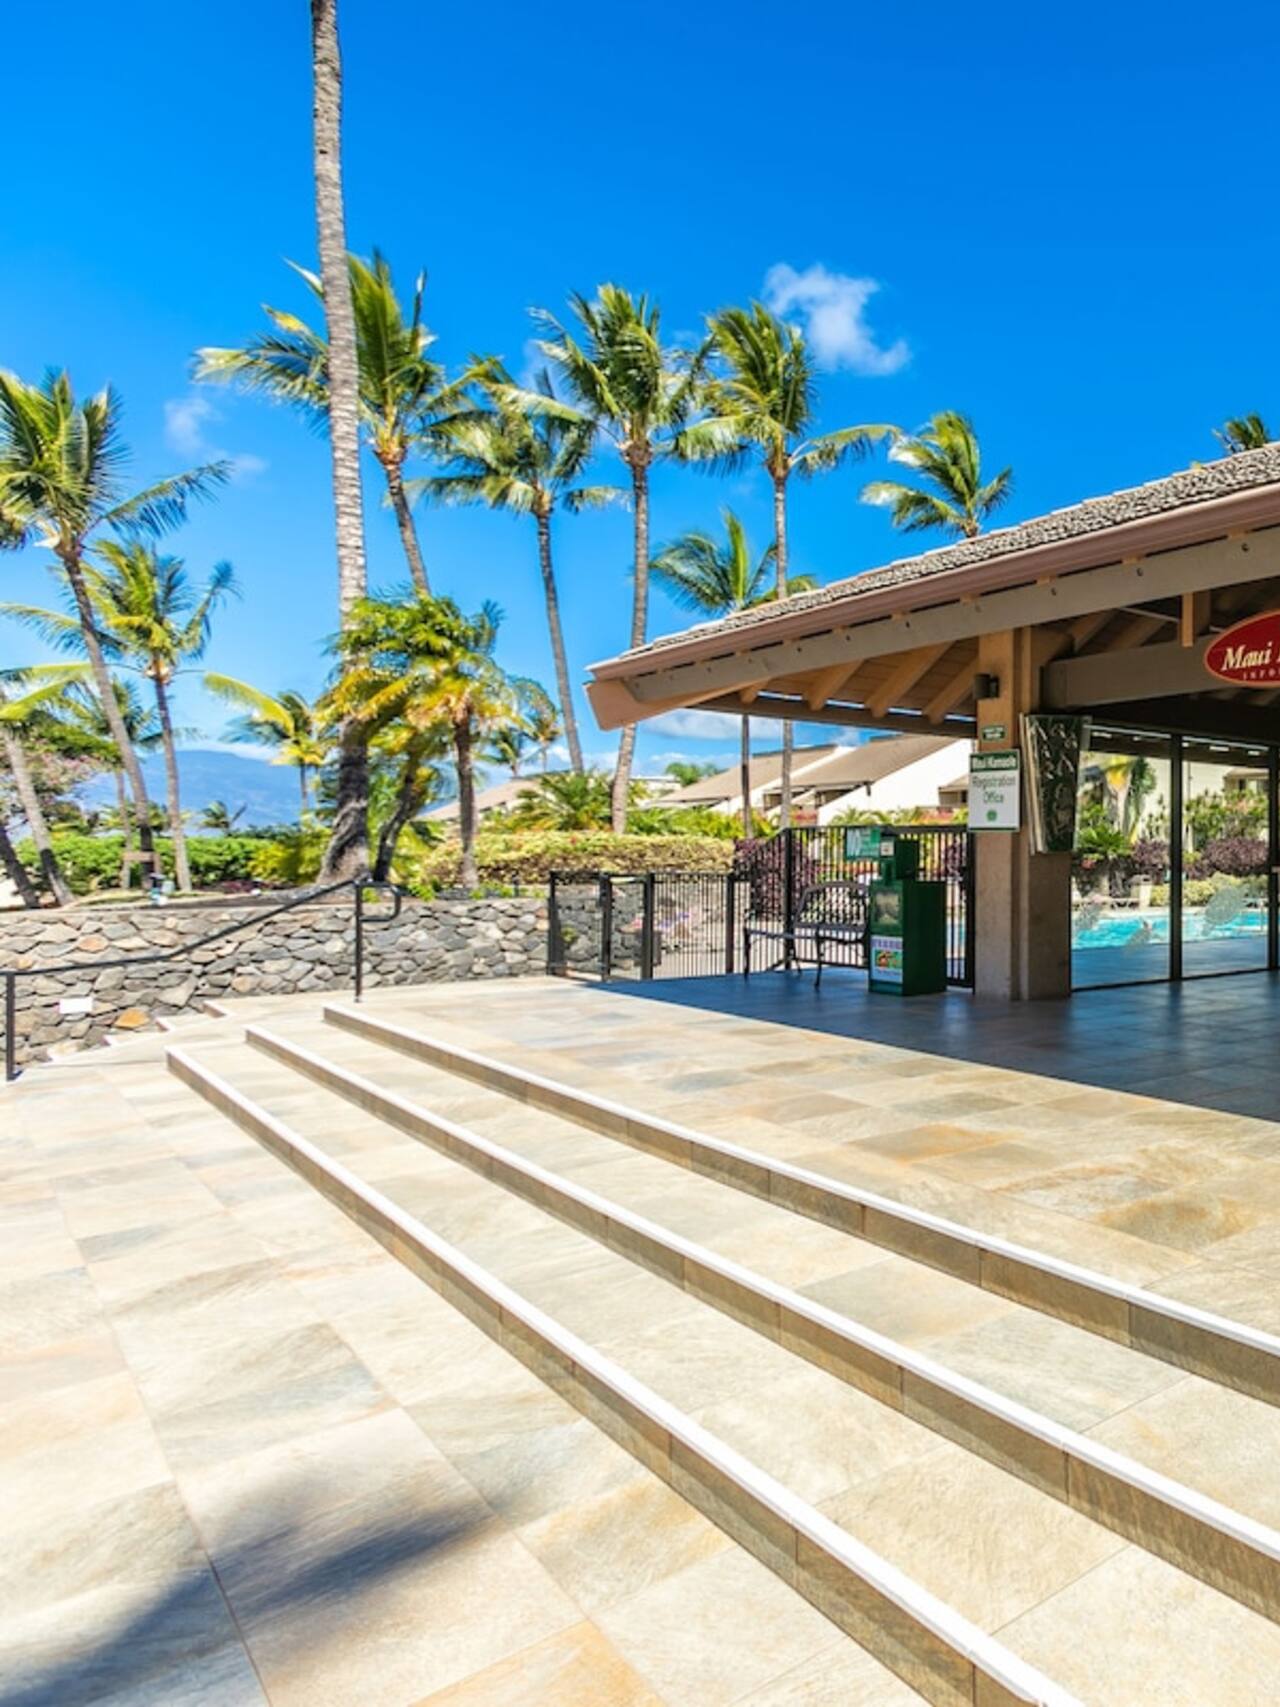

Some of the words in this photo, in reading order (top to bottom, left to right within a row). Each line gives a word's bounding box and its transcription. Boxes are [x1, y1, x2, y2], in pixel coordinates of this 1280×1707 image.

[1222, 642, 1272, 671] Maui
[972, 776, 1016, 789] Registration
[984, 791, 1004, 803] Office
